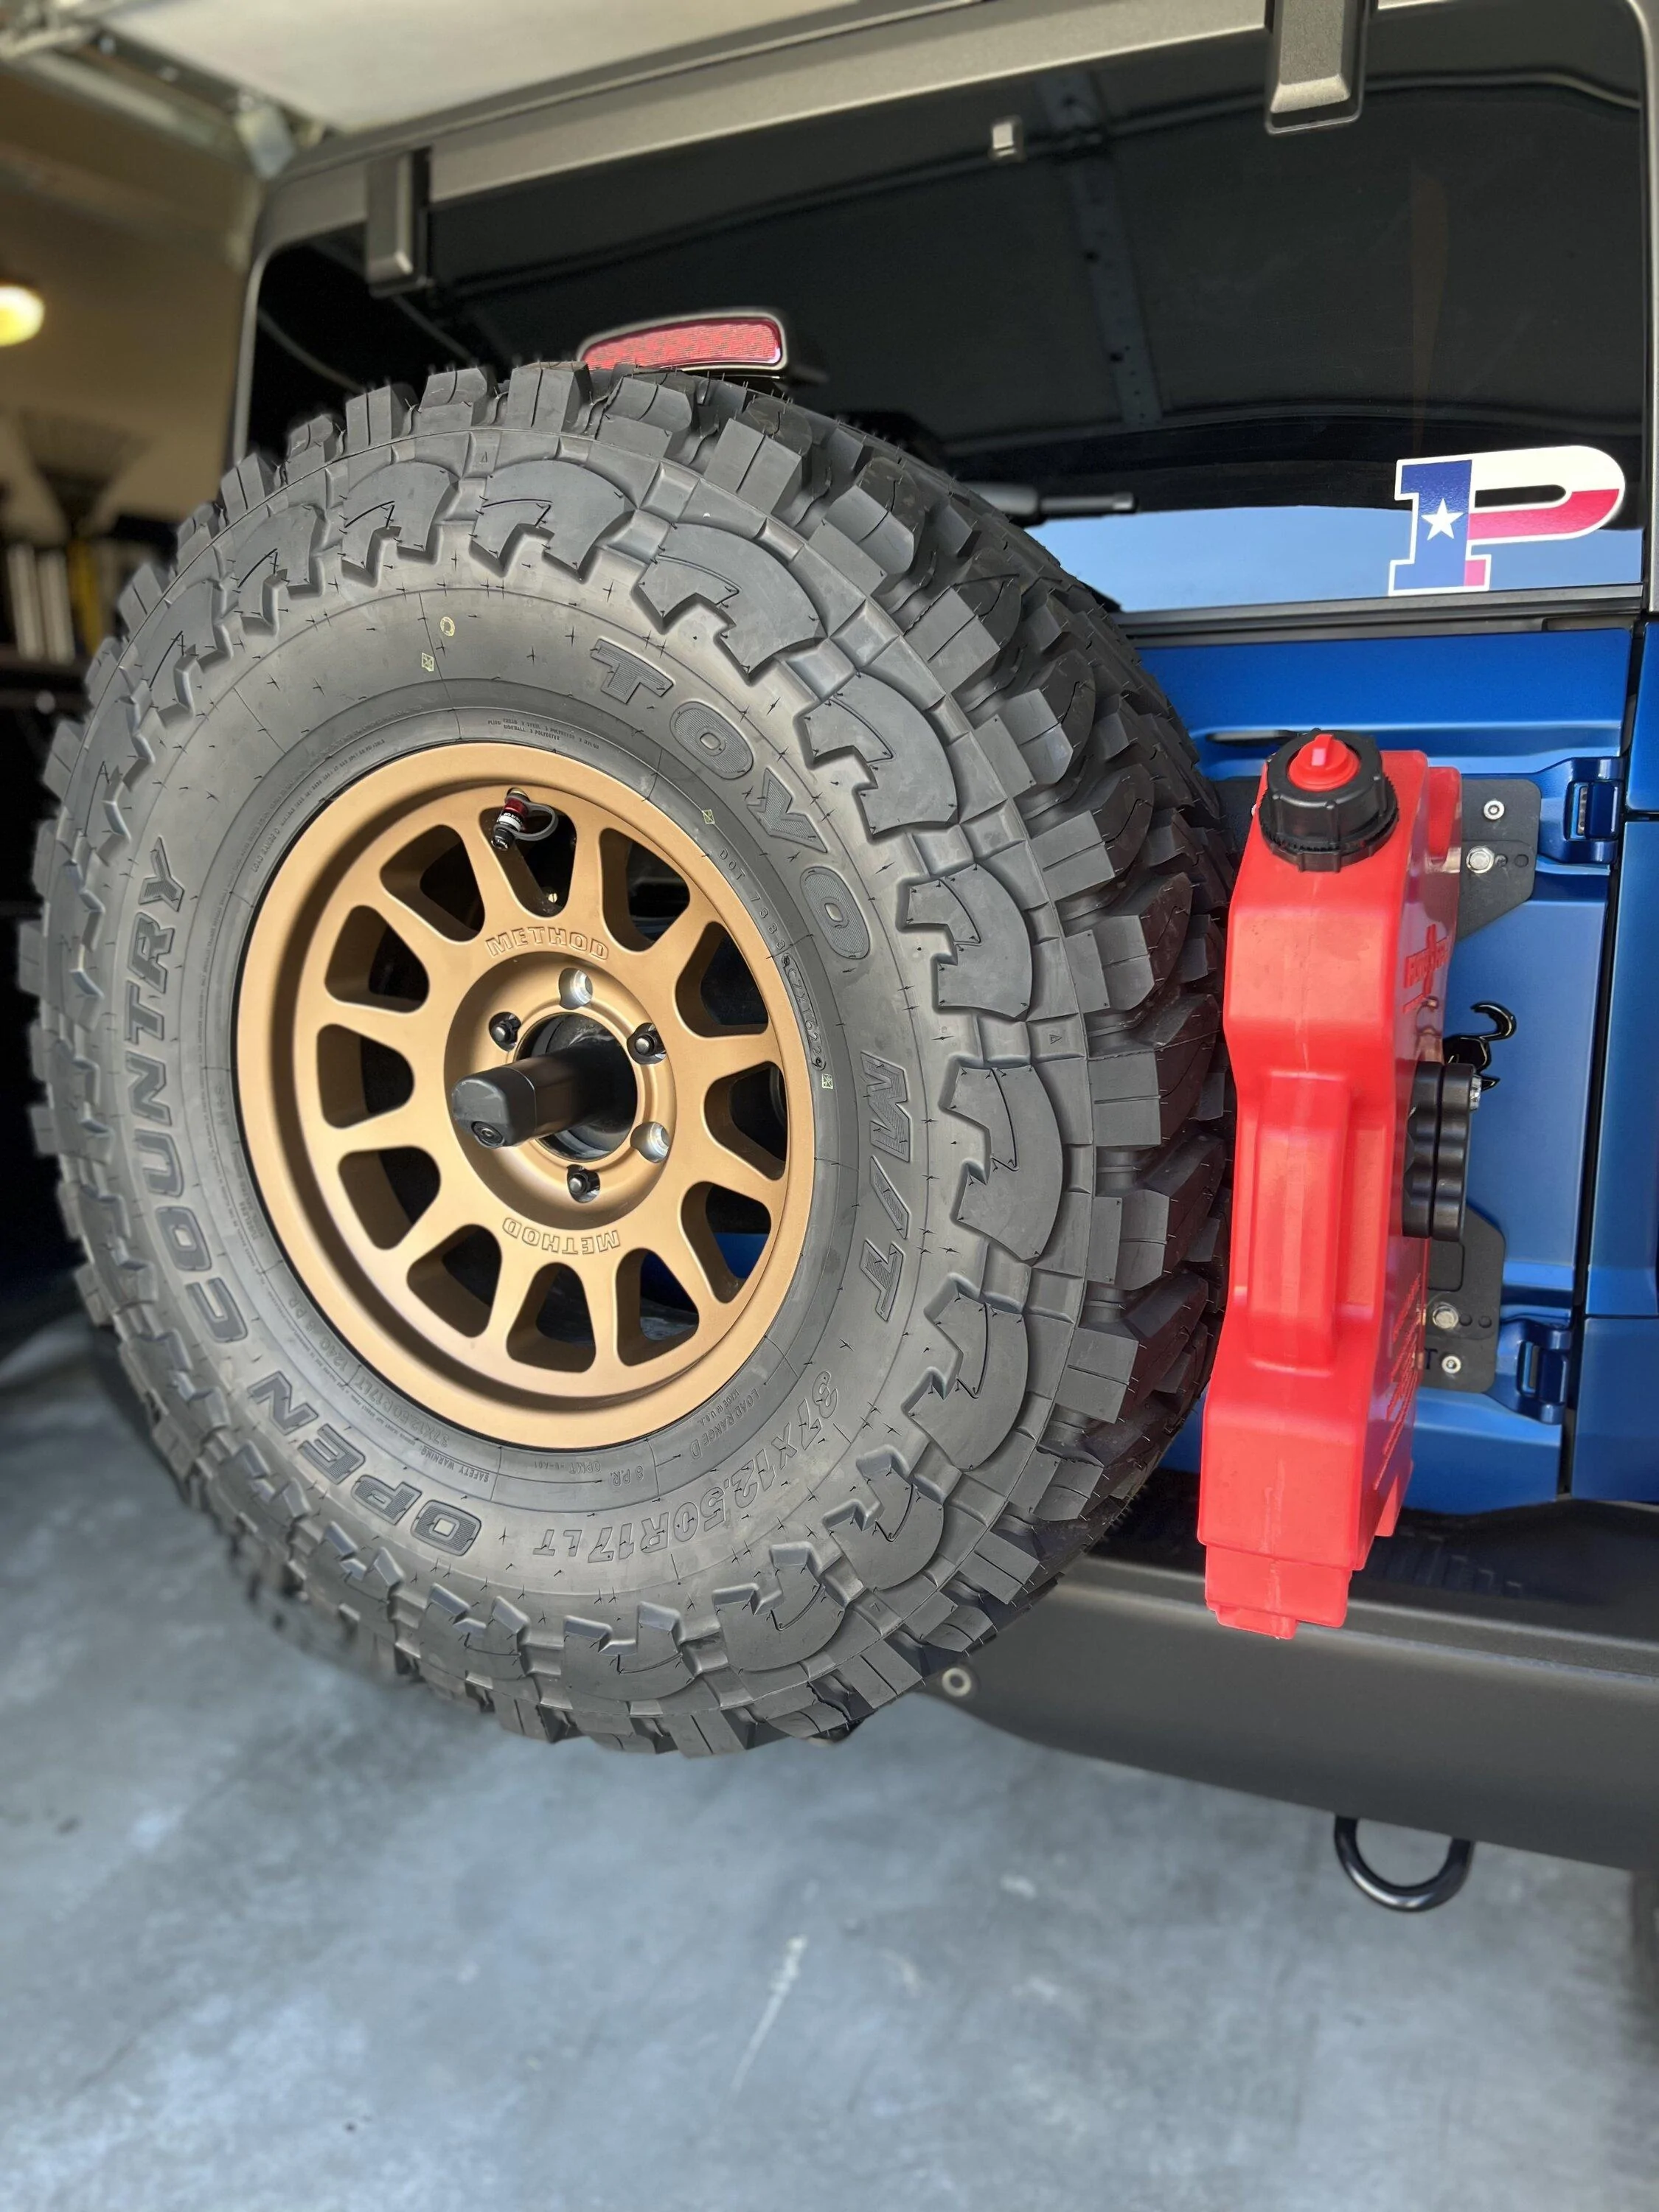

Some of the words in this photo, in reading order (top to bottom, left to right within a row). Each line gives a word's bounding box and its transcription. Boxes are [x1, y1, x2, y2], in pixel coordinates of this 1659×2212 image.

[590, 636, 872, 959] TOYO
[718, 847, 746, 880] DOT
[485, 926, 609, 961] METHOD
[125, 836, 248, 1343] COUNTRY
[859, 1051, 911, 1322] M/T
[502, 1217, 621, 1254] METHOD
[733, 1388, 759, 1419] LOAD
[700, 1413, 735, 1447] RANGE
[247, 1371, 481, 1556] OPEN
[690, 1439, 703, 1461] D
[458, 1465, 488, 1483] SAFETY
[636, 1464, 644, 1481] 8
